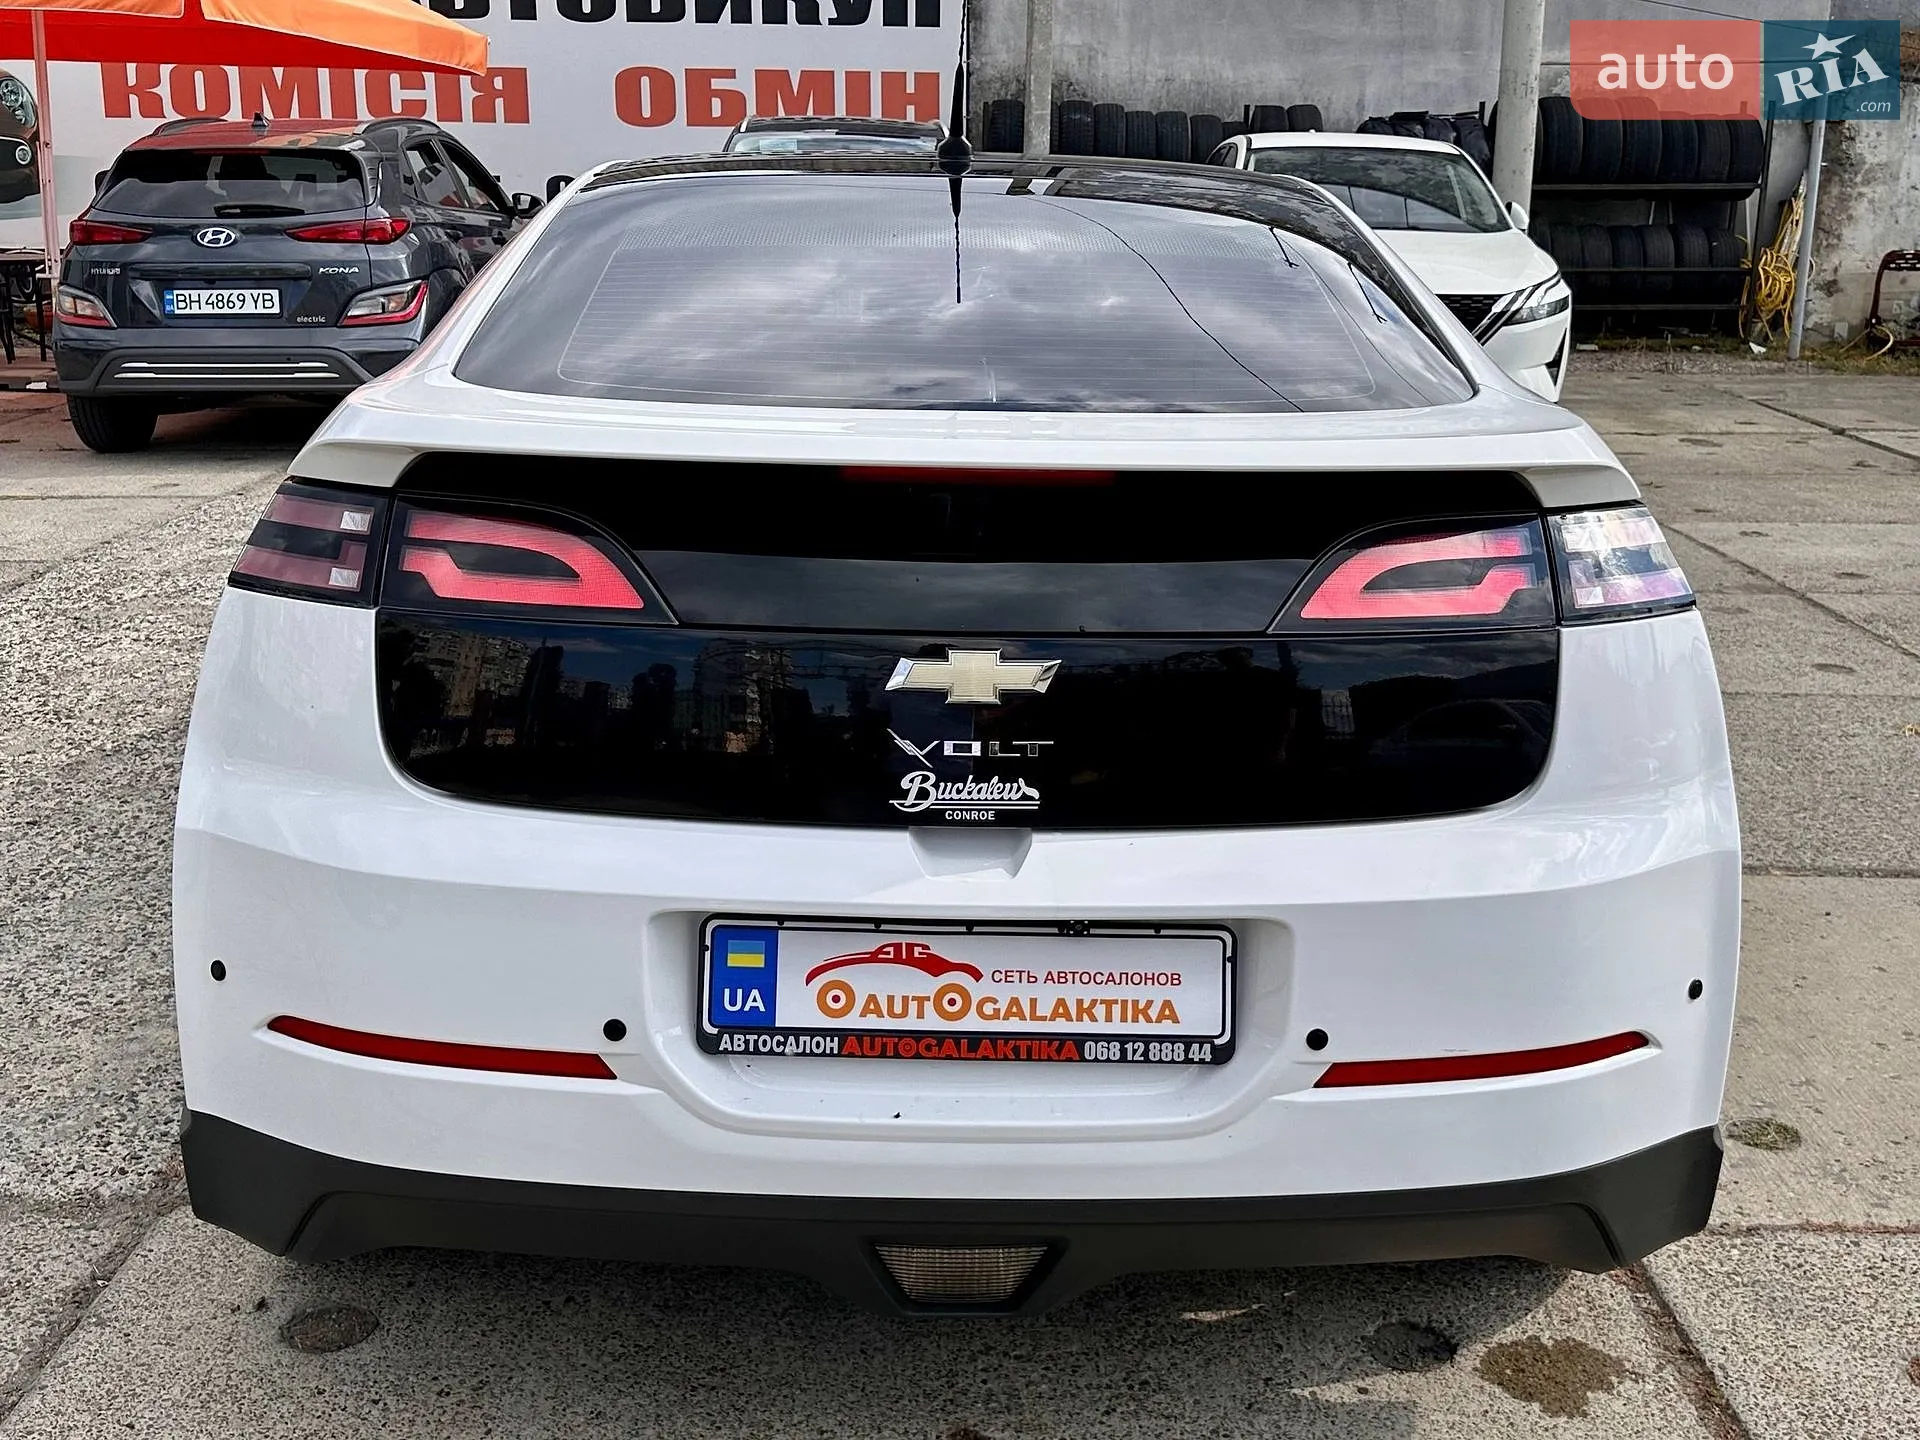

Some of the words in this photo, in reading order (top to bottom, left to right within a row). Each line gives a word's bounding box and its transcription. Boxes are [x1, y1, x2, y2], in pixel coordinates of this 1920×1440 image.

[100, 62, 529, 124] КОМІСІЯ
[614, 66, 941, 127] ОБМІН
[176, 293, 202, 310] BH
[205, 293, 246, 310] 4869
[250, 293, 275, 310] YB
[296, 315, 326, 323] electric
[887, 728, 1054, 768] VOLT
[897, 770, 1040, 813] Buckalew
[945, 810, 996, 820] CONROE
[991, 969, 1038, 984] СЕТЬ
[1043, 970, 1182, 986] АВТОСАЛОНОВ
[723, 988, 766, 1012] UA
[859, 982, 1181, 1024] AUTOGALAKTIKA
[719, 1033, 839, 1054] АВТОСАЛОН
[841, 1036, 1080, 1061] AUTOGALAKTIKA
[1084, 1041, 1121, 1061] 068
[1124, 1042, 1145, 1061] 12
[1149, 1042, 1185, 1062] 888
[1188, 1043, 1212, 1063] 44
